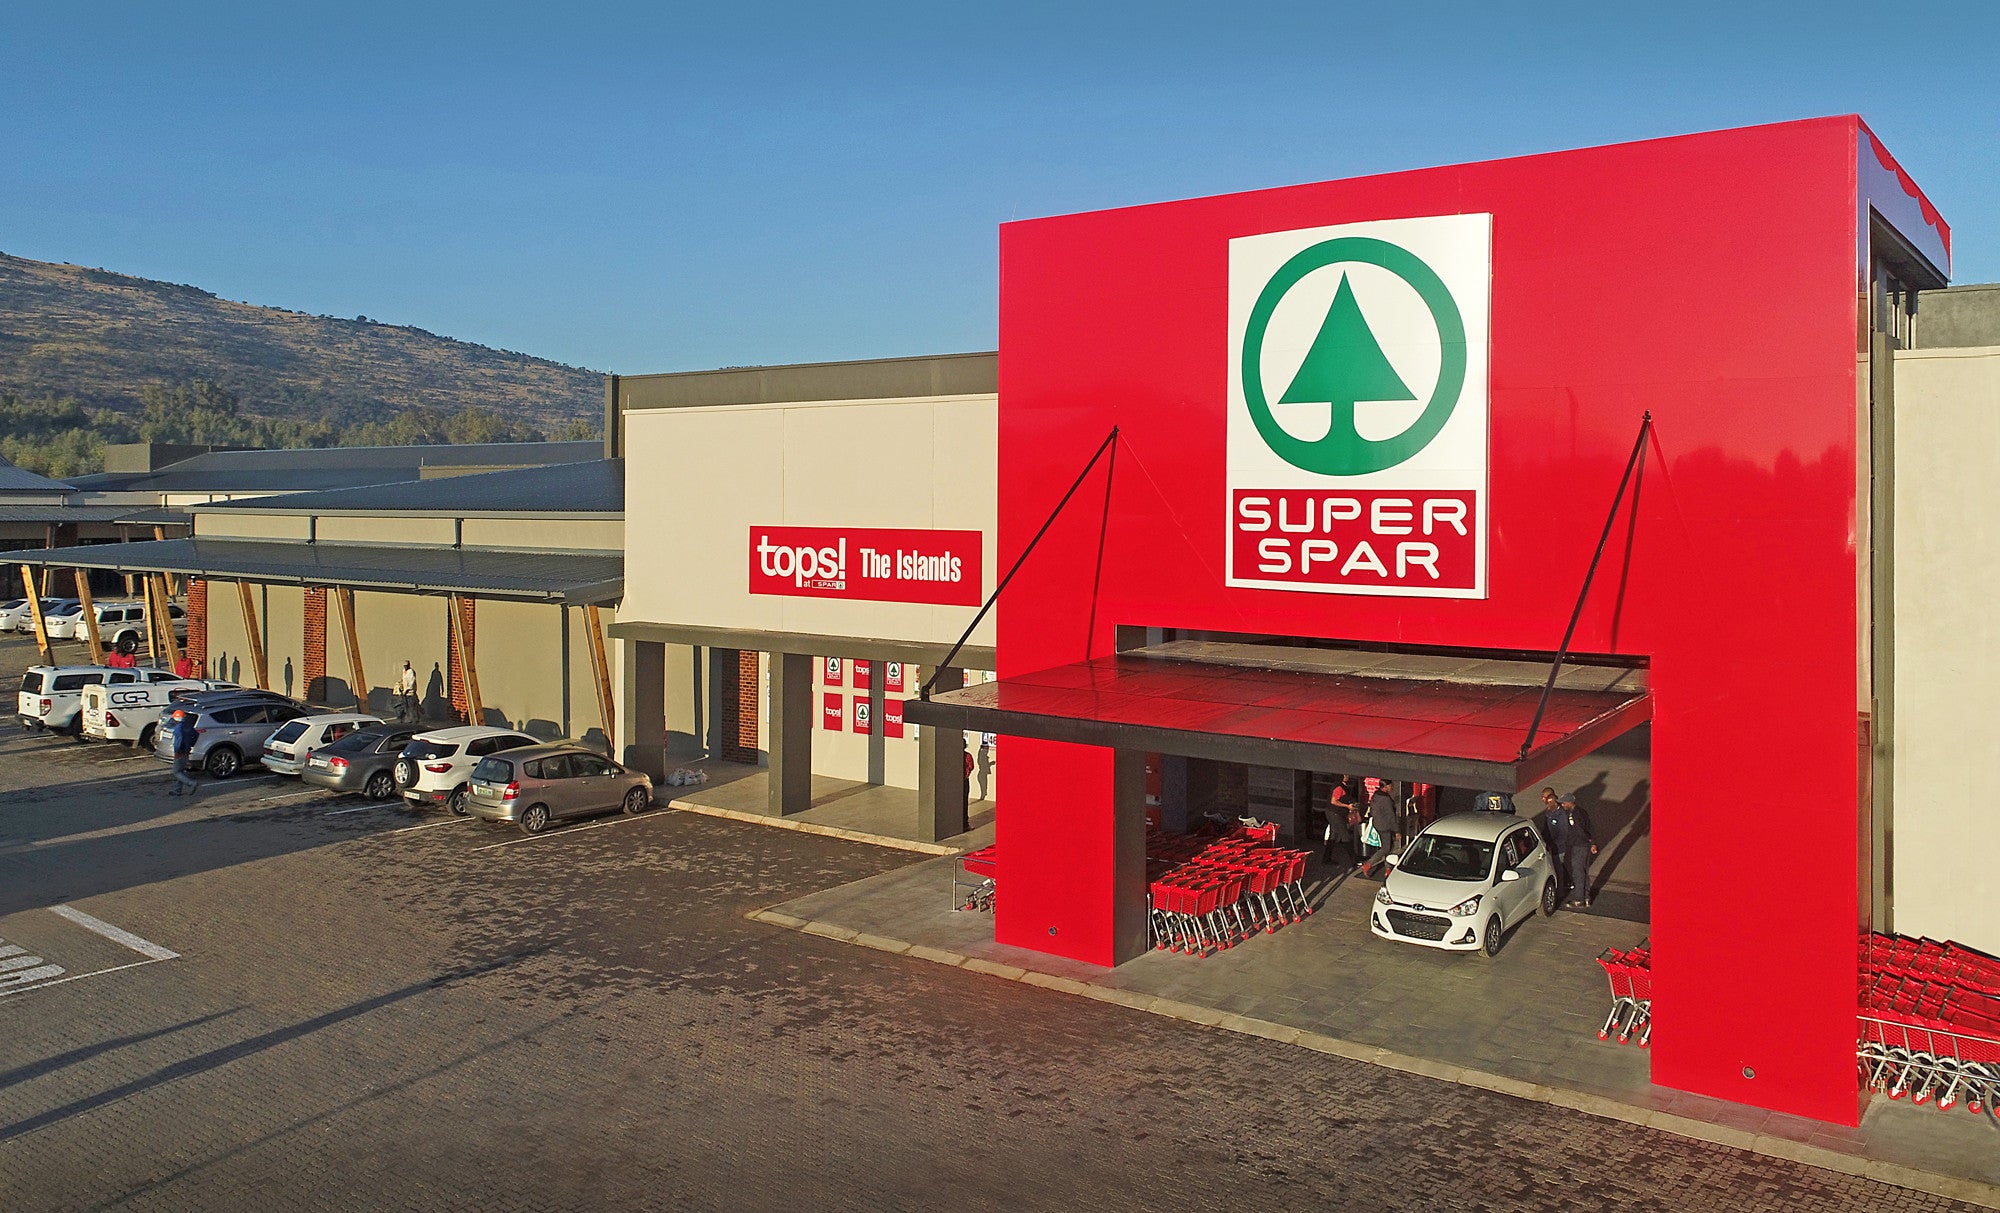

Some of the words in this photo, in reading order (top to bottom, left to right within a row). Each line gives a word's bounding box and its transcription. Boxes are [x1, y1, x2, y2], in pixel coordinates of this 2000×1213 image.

[1239, 497, 1468, 536] SUPER
[757, 535, 846, 588] tops!
[859, 548, 891, 579] The
[896, 549, 962, 582] Islands
[1258, 538, 1440, 580] SPAR
[803, 579, 811, 588] at
[111, 690, 150, 704] CGR
